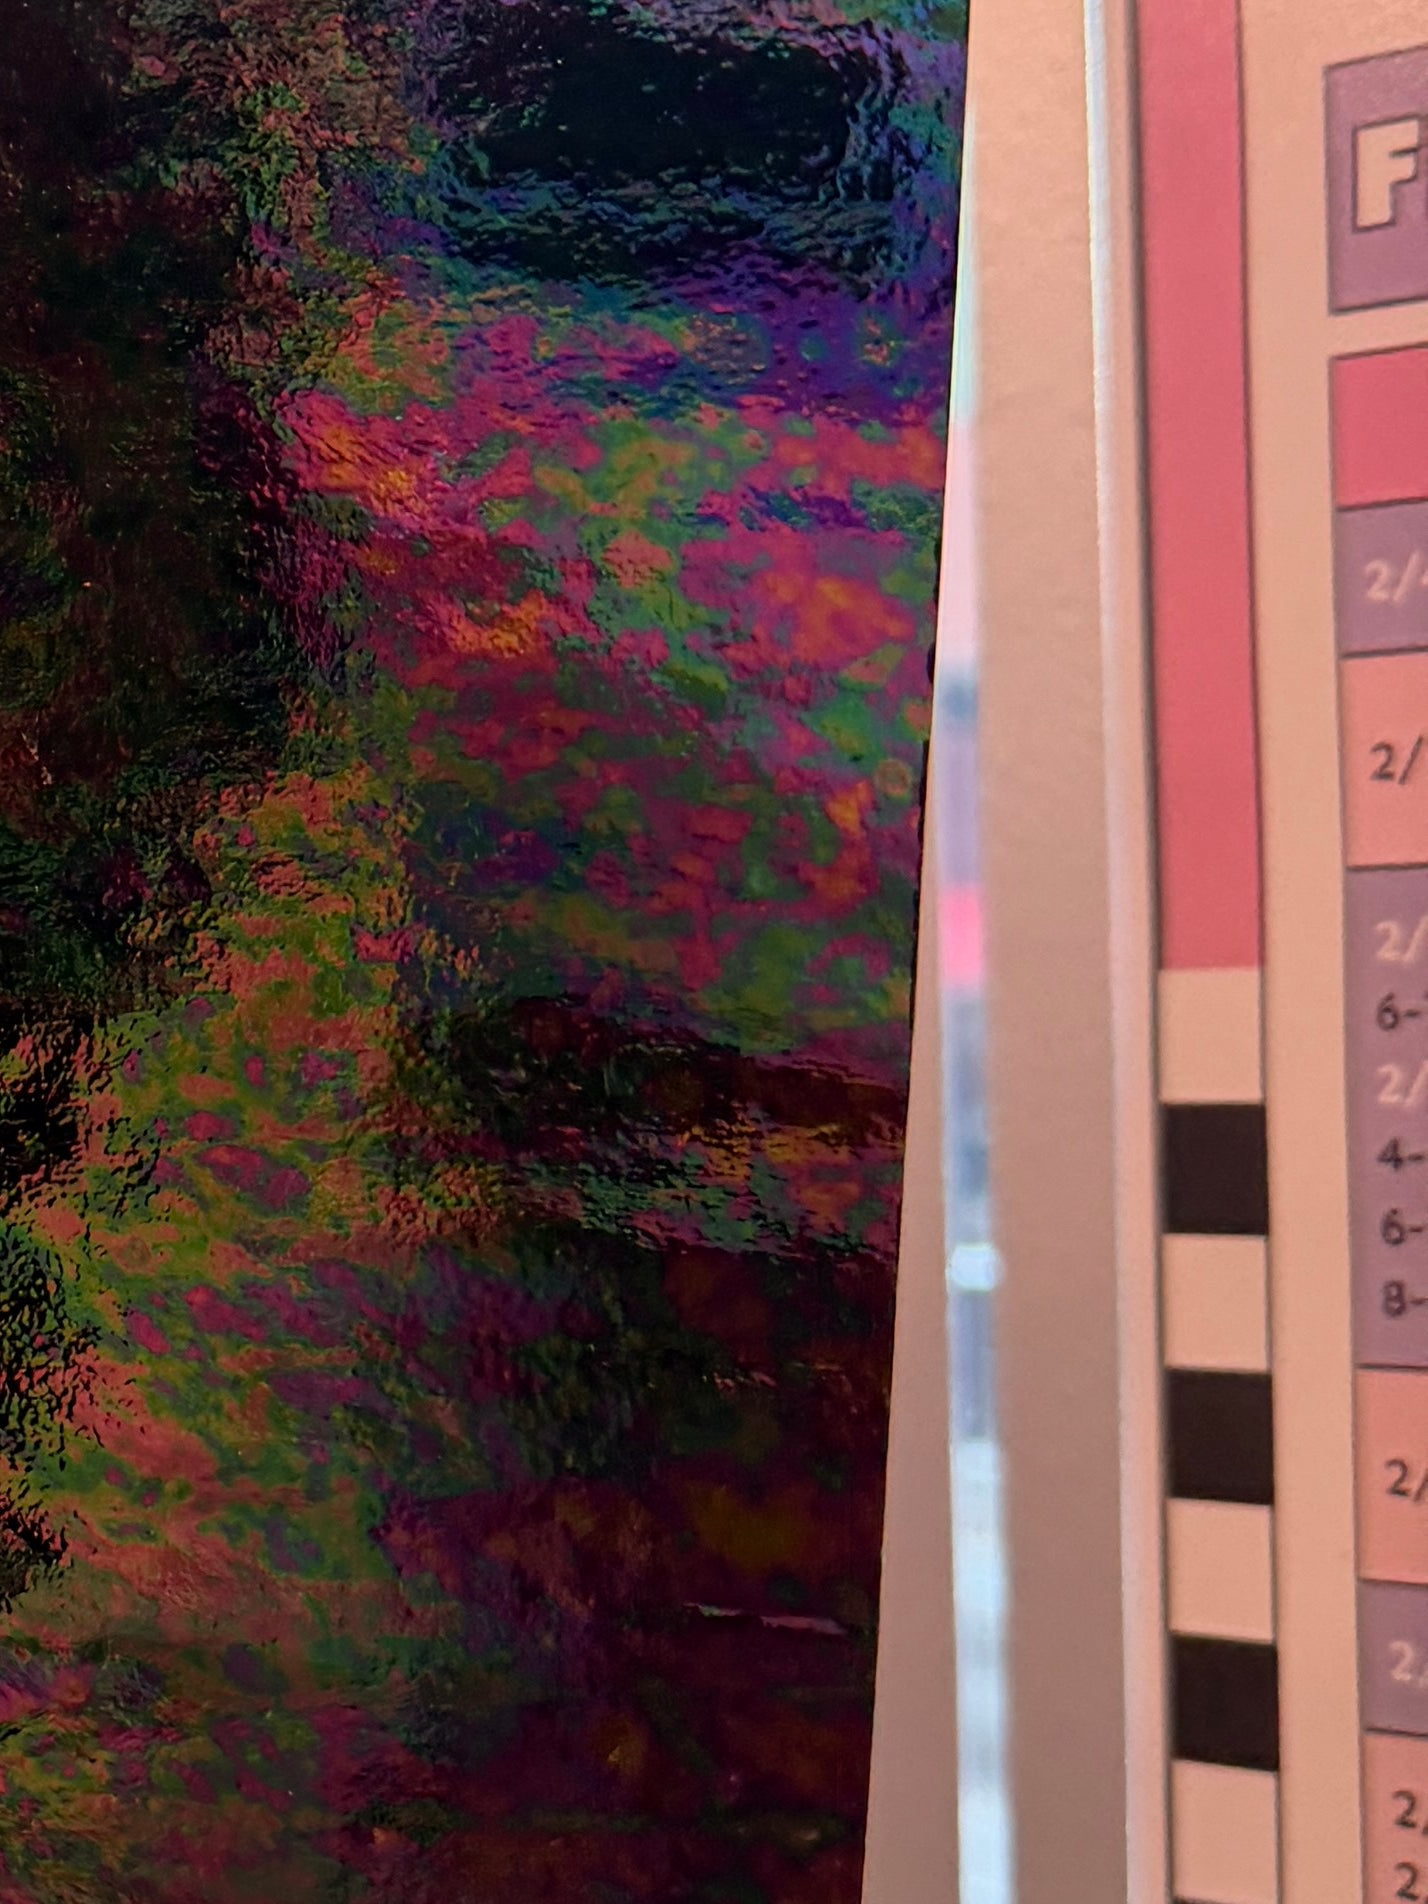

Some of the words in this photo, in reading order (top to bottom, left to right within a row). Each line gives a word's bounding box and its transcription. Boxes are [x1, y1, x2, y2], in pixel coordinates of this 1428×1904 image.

[1351, 114, 1428, 234] F
[1363, 549, 1428, 602] 2/
[1376, 992, 1428, 1031] 6-
